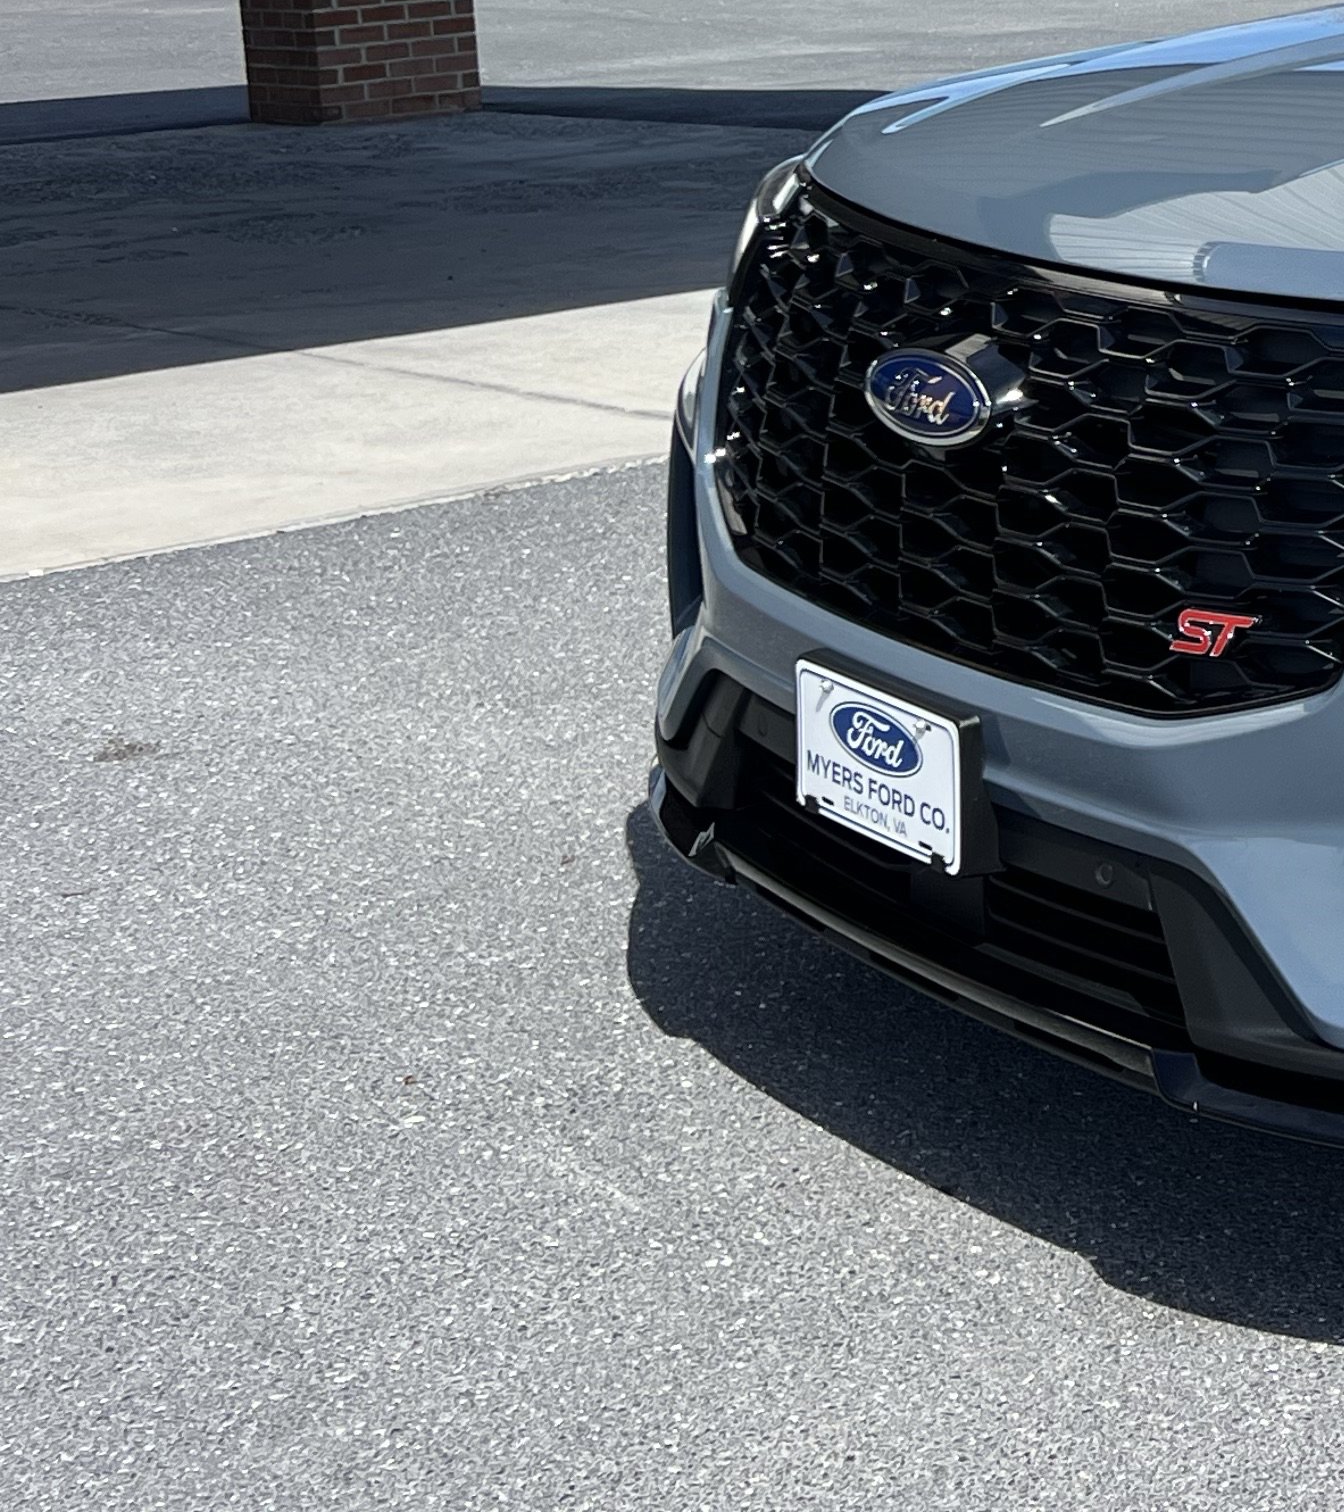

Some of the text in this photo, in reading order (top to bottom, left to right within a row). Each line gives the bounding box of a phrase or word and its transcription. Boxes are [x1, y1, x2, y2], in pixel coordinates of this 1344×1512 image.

[885, 367, 956, 425] Ford
[1169, 608, 1259, 657] ST
[846, 711, 905, 768] Ford
[807, 749, 950, 834] MYERS FORD CO.
[843, 795, 908, 837] ELKTON, VA
